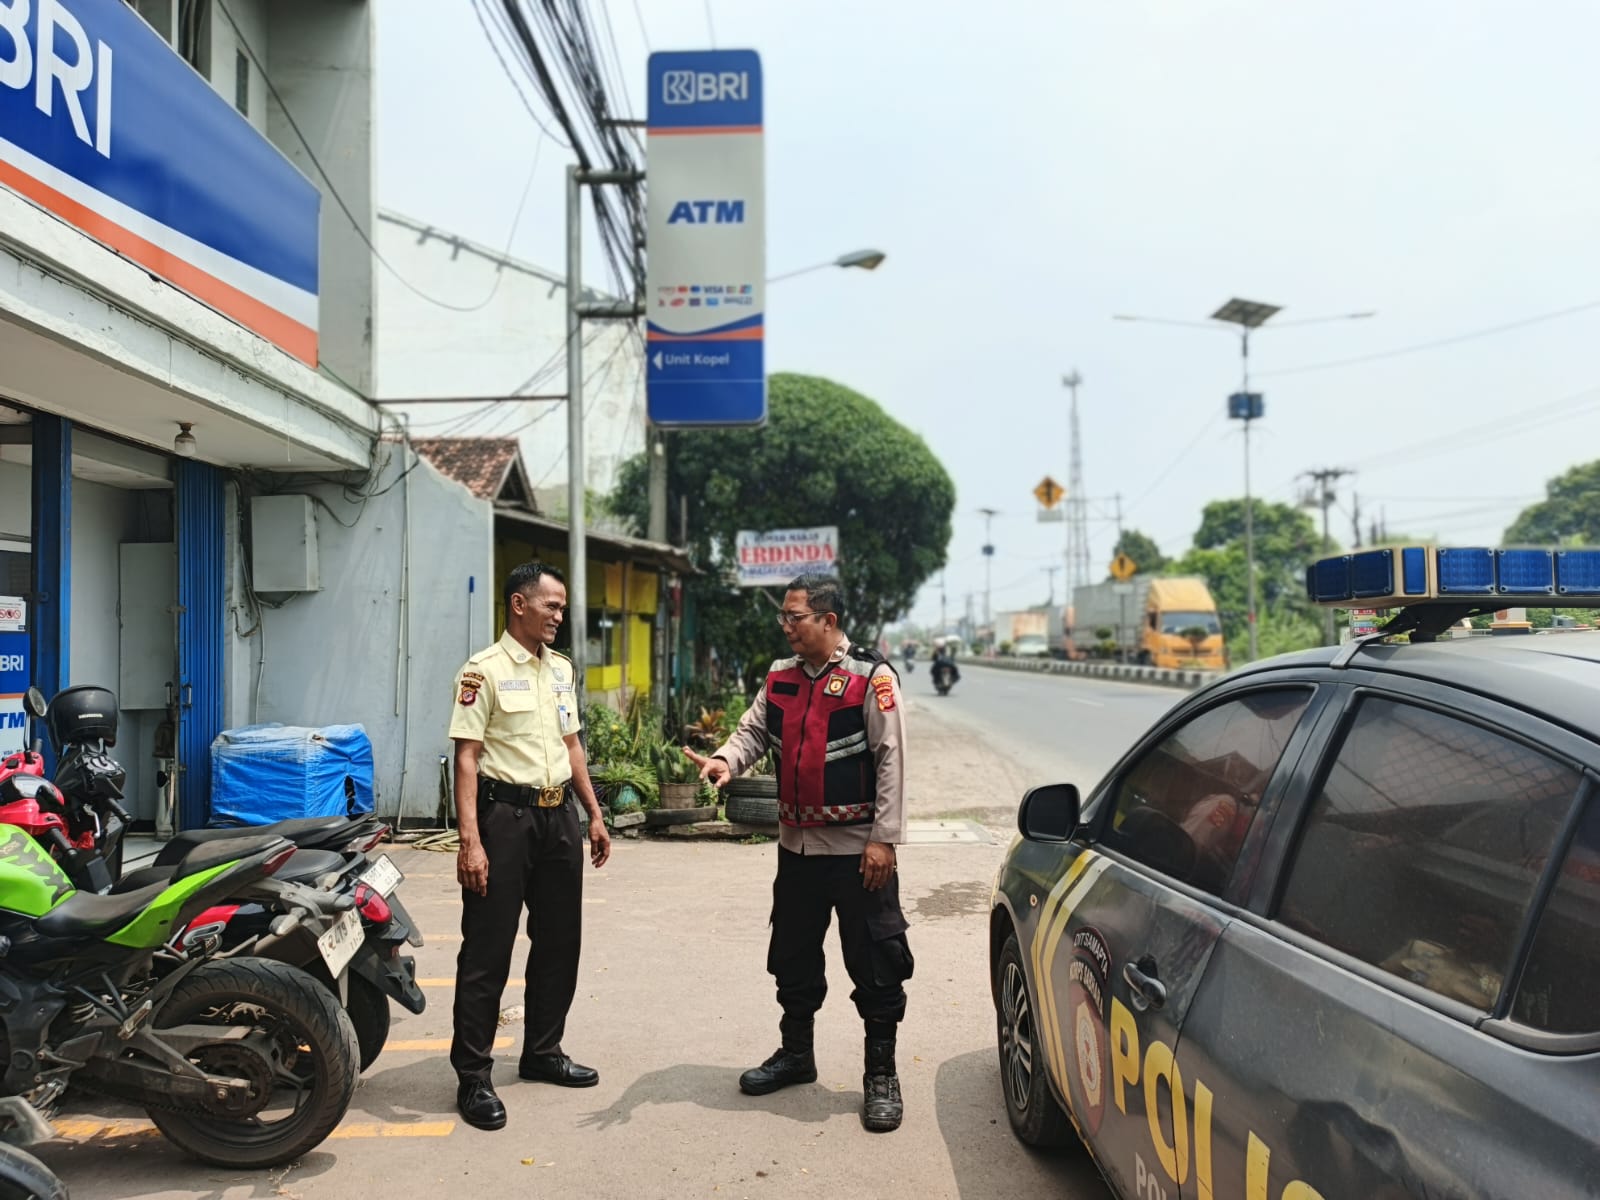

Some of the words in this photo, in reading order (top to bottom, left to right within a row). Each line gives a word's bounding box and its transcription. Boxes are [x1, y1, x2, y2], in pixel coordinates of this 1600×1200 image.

[698, 72, 748, 101] BRI
[667, 201, 745, 224] ATM
[665, 353, 690, 365] Unit
[694, 352, 730, 367] Kopel
[741, 543, 834, 563] ERDINDA
[0, 655, 24, 671] BRI
[0, 712, 25, 729] TM
